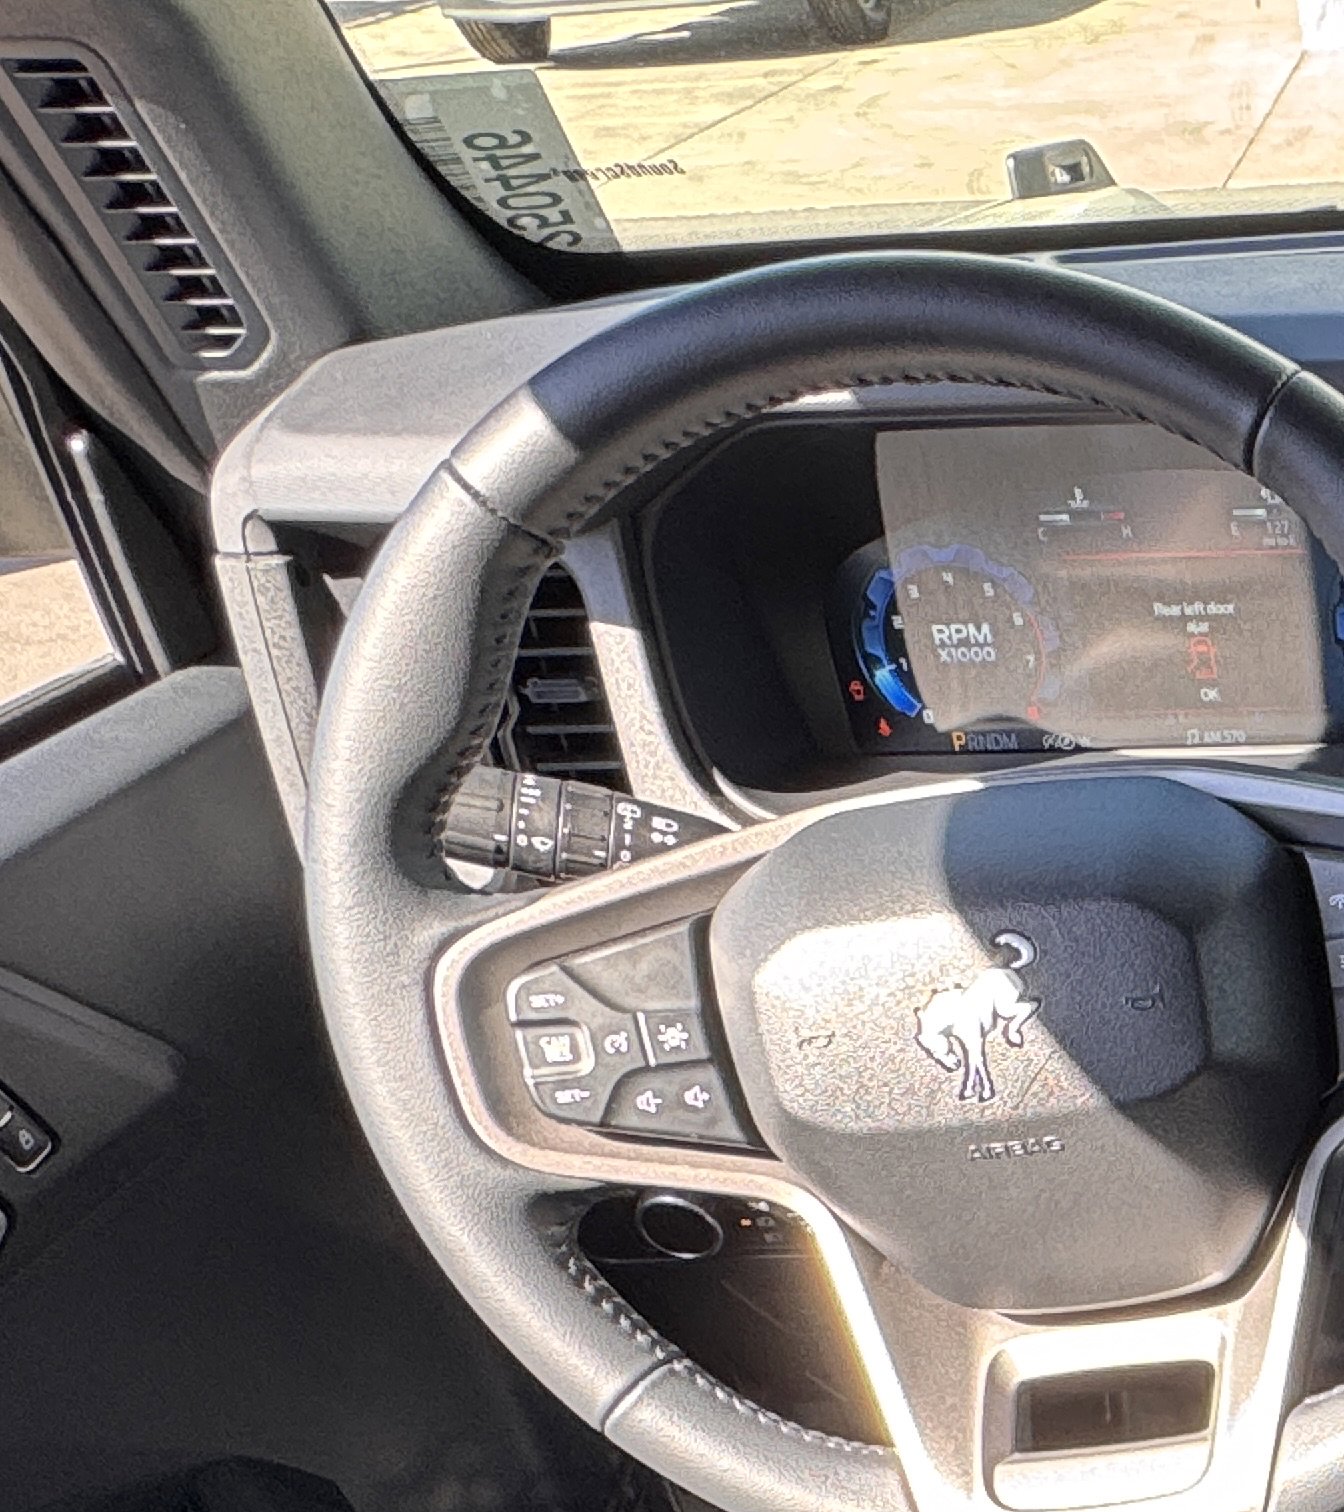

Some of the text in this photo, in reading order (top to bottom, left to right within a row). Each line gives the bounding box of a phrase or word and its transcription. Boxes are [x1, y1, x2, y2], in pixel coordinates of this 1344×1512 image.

[1183, 602, 1204, 616] left
[1205, 602, 1235, 616] door
[931, 622, 994, 646] RPM
